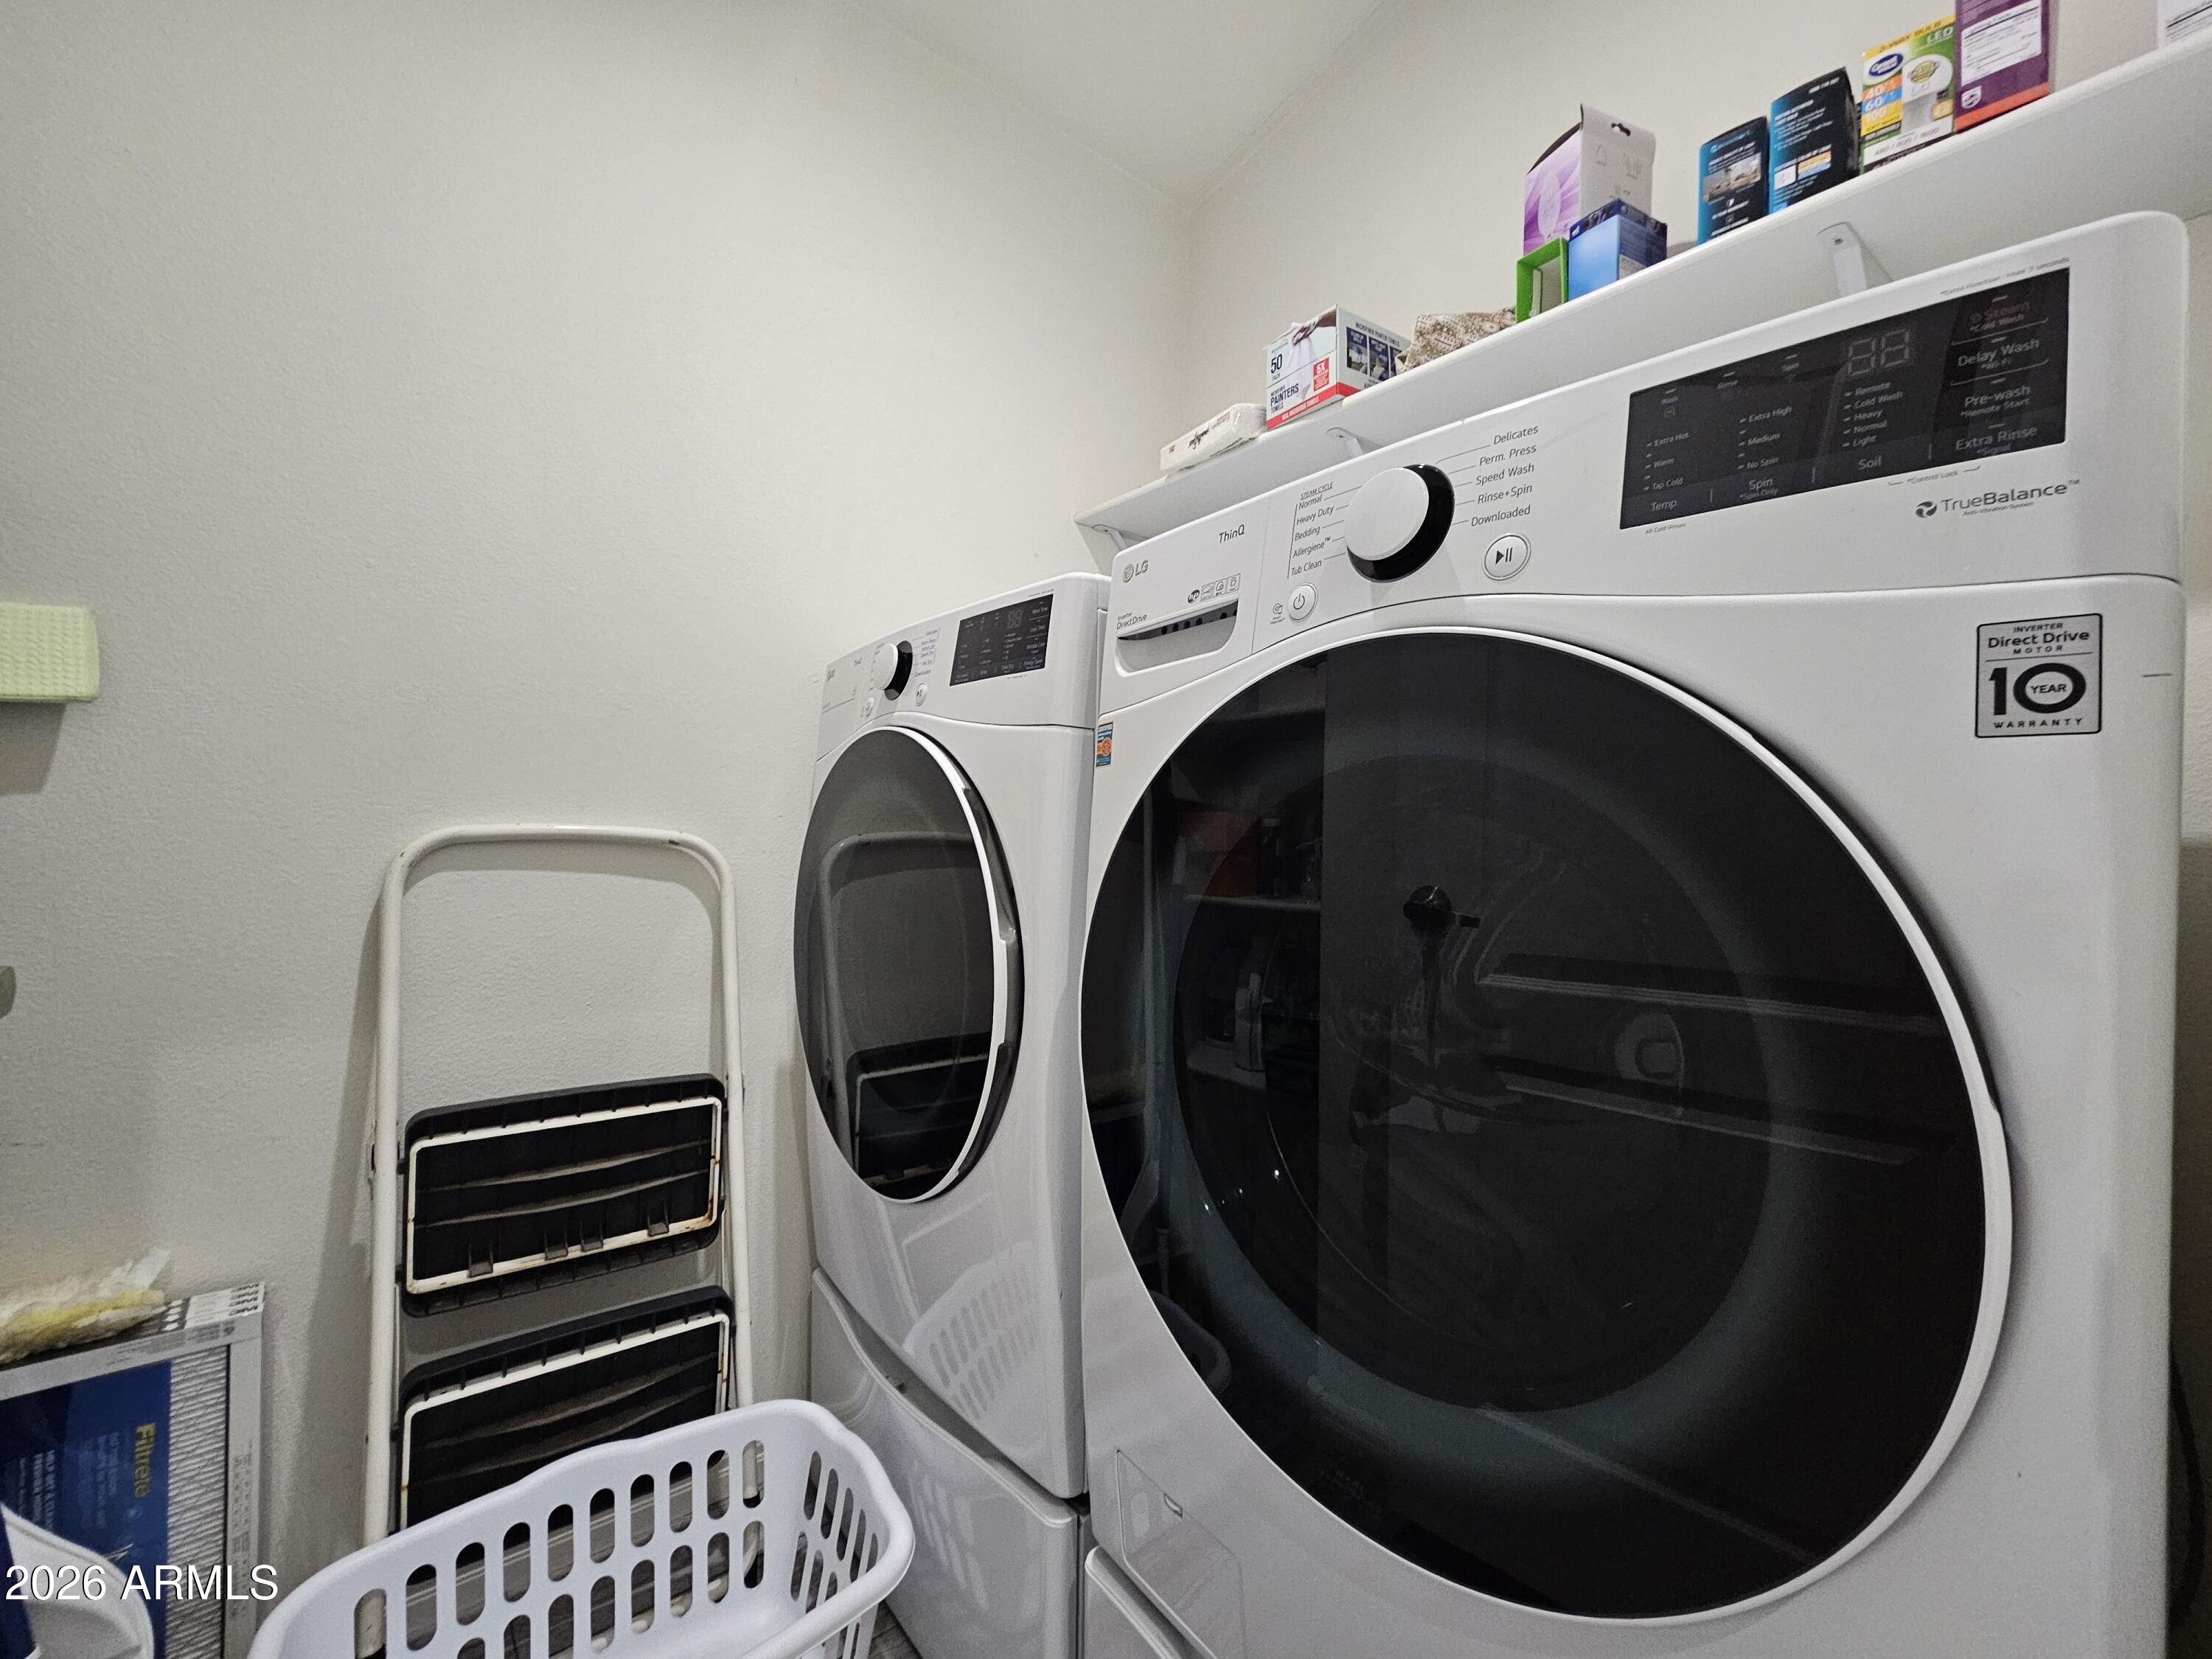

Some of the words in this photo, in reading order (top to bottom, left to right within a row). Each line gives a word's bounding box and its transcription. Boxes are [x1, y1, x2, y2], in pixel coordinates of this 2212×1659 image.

[1927, 26, 1954, 44] LED
[1958, 349, 1997, 367] Delay
[2001, 338, 2040, 355] Wash
[1270, 354, 1283, 374] 50
[1270, 383, 1299, 407] PAINTERS
[1854, 396, 1876, 409] Cold
[1878, 390, 1903, 403] Wash
[1964, 385, 2031, 408] Pre-wash
[1747, 412, 1771, 423] Extra
[1772, 405, 1792, 417] High
[1854, 410, 1882, 421] Heavy
[1494, 425, 1539, 445] Delicates
[1853, 420, 1888, 434] Normal
[1674, 431, 1689, 441] Hot
[1747, 432, 1781, 446] Medium
[1853, 435, 1877, 447] Light
[1955, 434, 1994, 451] Extra
[1997, 426, 2038, 442] Rinse
[1479, 453, 1506, 467] Perm.
[1509, 445, 1537, 459] Press
[1653, 457, 1674, 468] Warm
[1747, 460, 1760, 470] No
[1760, 456, 1779, 468] Spin
[1858, 456, 1882, 470] Soil
[1475, 468, 1506, 487] Speed
[1508, 462, 1535, 478] Wash
[1666, 476, 1683, 487] Cold
[1748, 476, 1773, 490] Spin
[1300, 488, 1318, 501] STEAM
[1318, 481, 1334, 493] CYCLE
[1478, 484, 1533, 504] Rinse+Spin
[1298, 494, 1323, 510] Normal
[1652, 499, 1679, 512] Temp.
[1296, 512, 1317, 525] Heavy
[1317, 505, 1335, 518] Duty
[1471, 504, 1531, 526] Downloaded
[1219, 524, 1245, 543] ThinQ
[1294, 526, 1321, 542] Bedding
[1135, 560, 1149, 576] LG
[1291, 565, 1302, 576] Tub
[1304, 560, 1322, 572] Clean
[2013, 622, 2063, 633] INVERTER
[1988, 635, 2038, 649] Direct
[2042, 630, 2090, 644] Drive
[2013, 644, 2063, 655] MOTOR
[1989, 662, 2087, 715] 10
[2030, 684, 2067, 694] YEAR
[1994, 717, 2083, 728] WARRANTY
[133, 1422, 156, 1499] Filtrete
